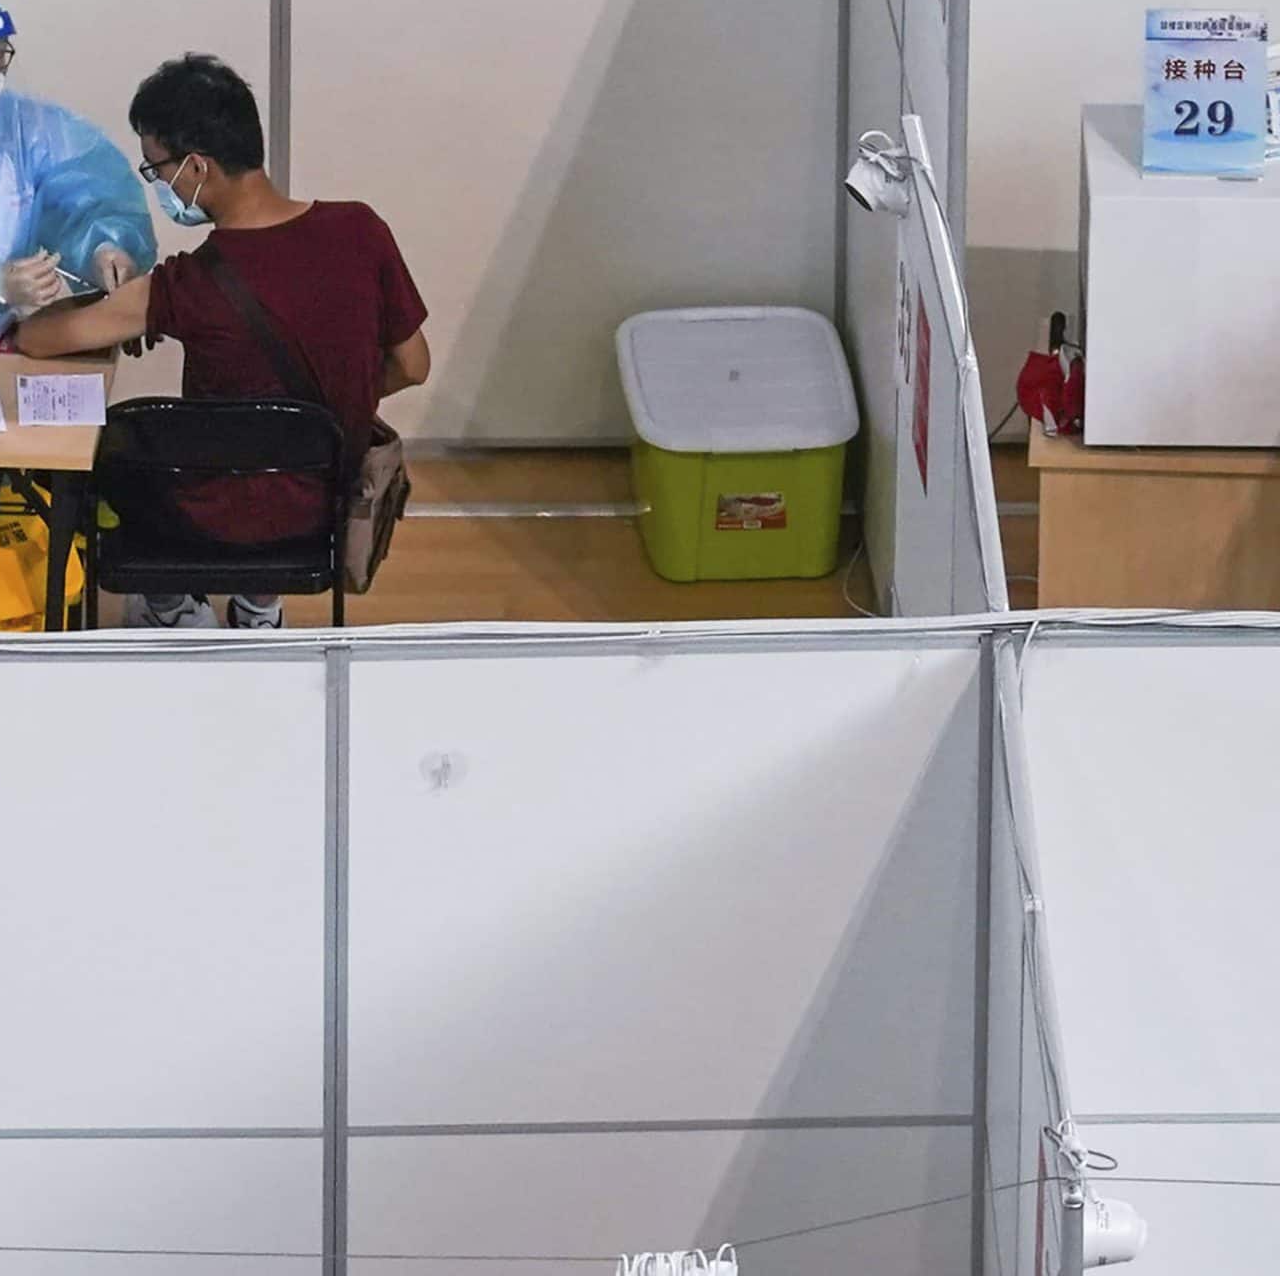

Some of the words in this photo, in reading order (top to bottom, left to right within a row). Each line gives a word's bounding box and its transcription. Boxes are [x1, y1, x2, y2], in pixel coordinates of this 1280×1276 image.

[1163, 58, 1247, 81] 接种台
[1173, 99, 1234, 136] 29
